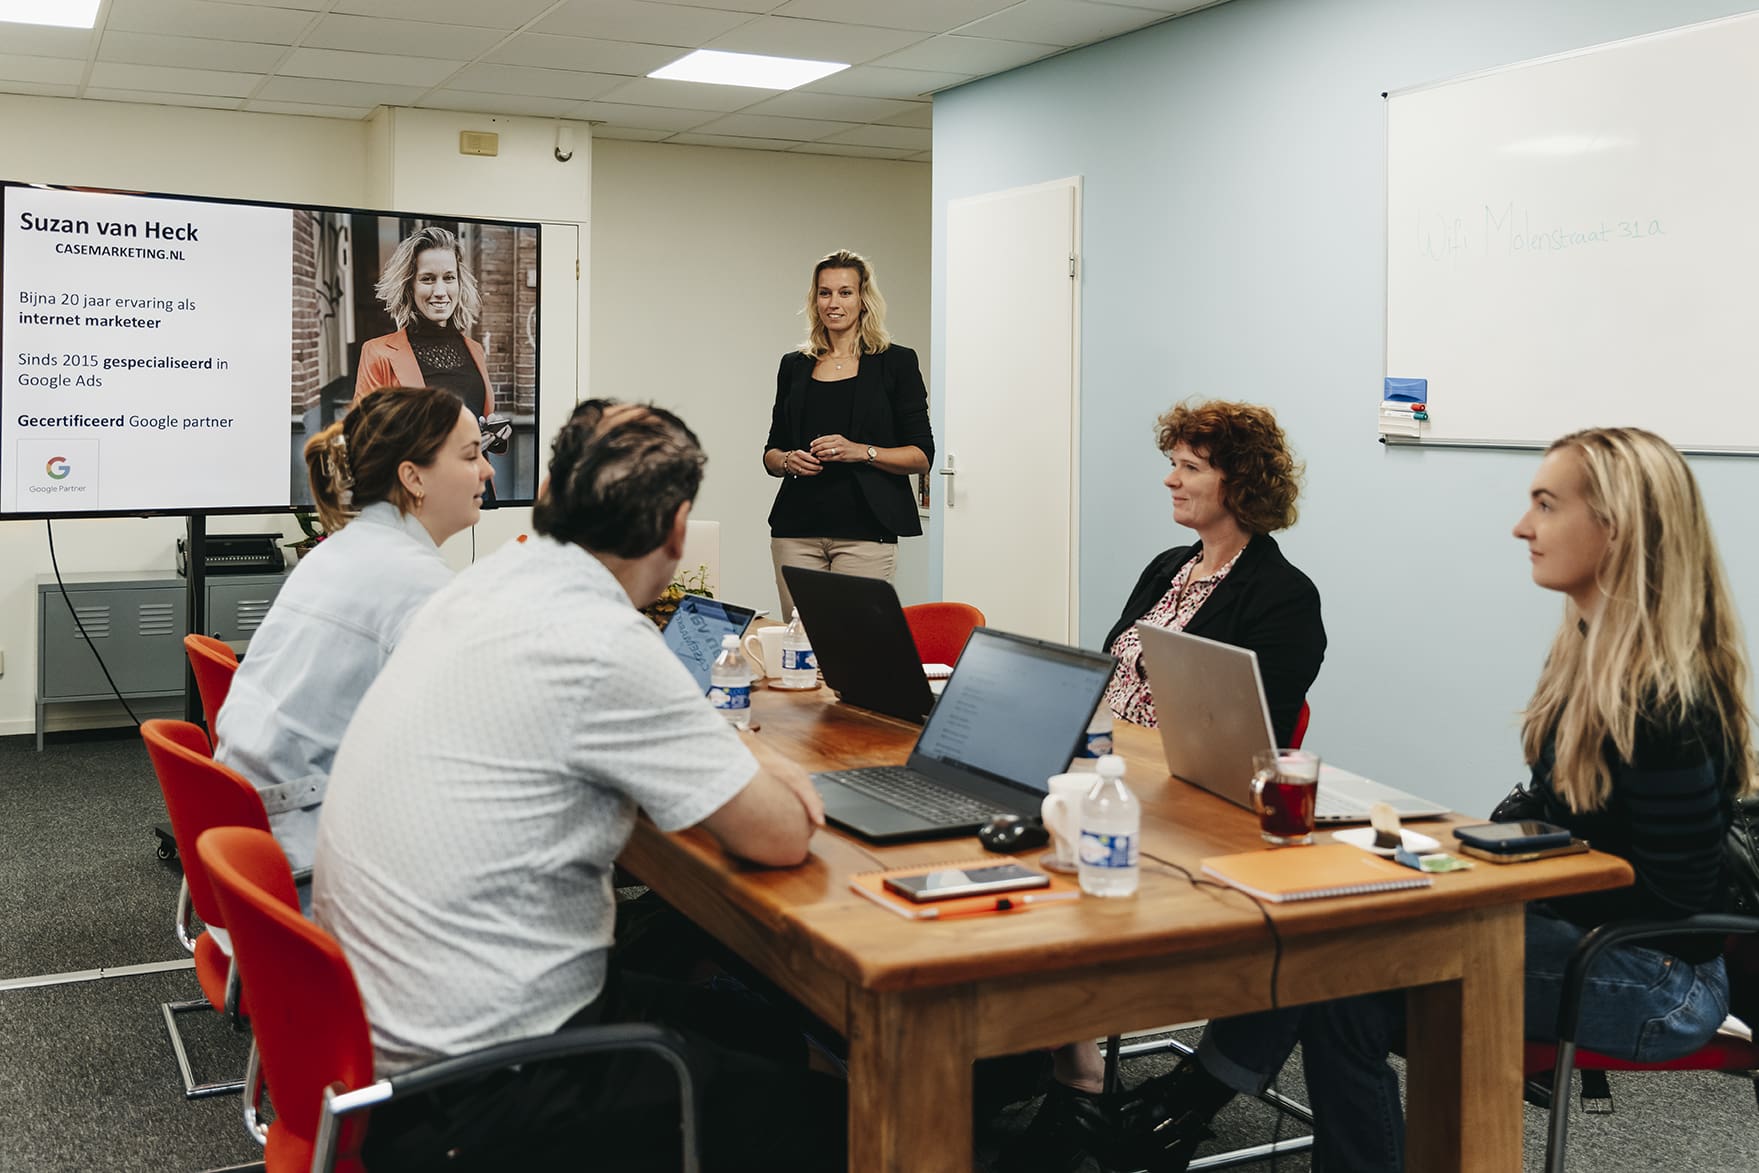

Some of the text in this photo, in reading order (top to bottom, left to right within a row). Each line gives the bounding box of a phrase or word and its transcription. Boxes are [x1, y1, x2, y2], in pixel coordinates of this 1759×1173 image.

[20, 212, 199, 241] Suzan van Heck
[1417, 208, 1469, 270] Wifi
[1484, 201, 1613, 256] Molenstraat
[55, 243, 185, 261] CASEMARKETING.NL
[19, 291, 196, 312] Bijna 20 jaar ervaring als
[19, 312, 161, 329] internet marketeer
[17, 353, 229, 370] Sinds 2015 gespecialiseerd in
[18, 373, 103, 389] Google Ads
[17, 415, 234, 431] Gecertificeerd Google partner
[46, 456, 71, 480] G
[29, 484, 87, 494] Google Partner
